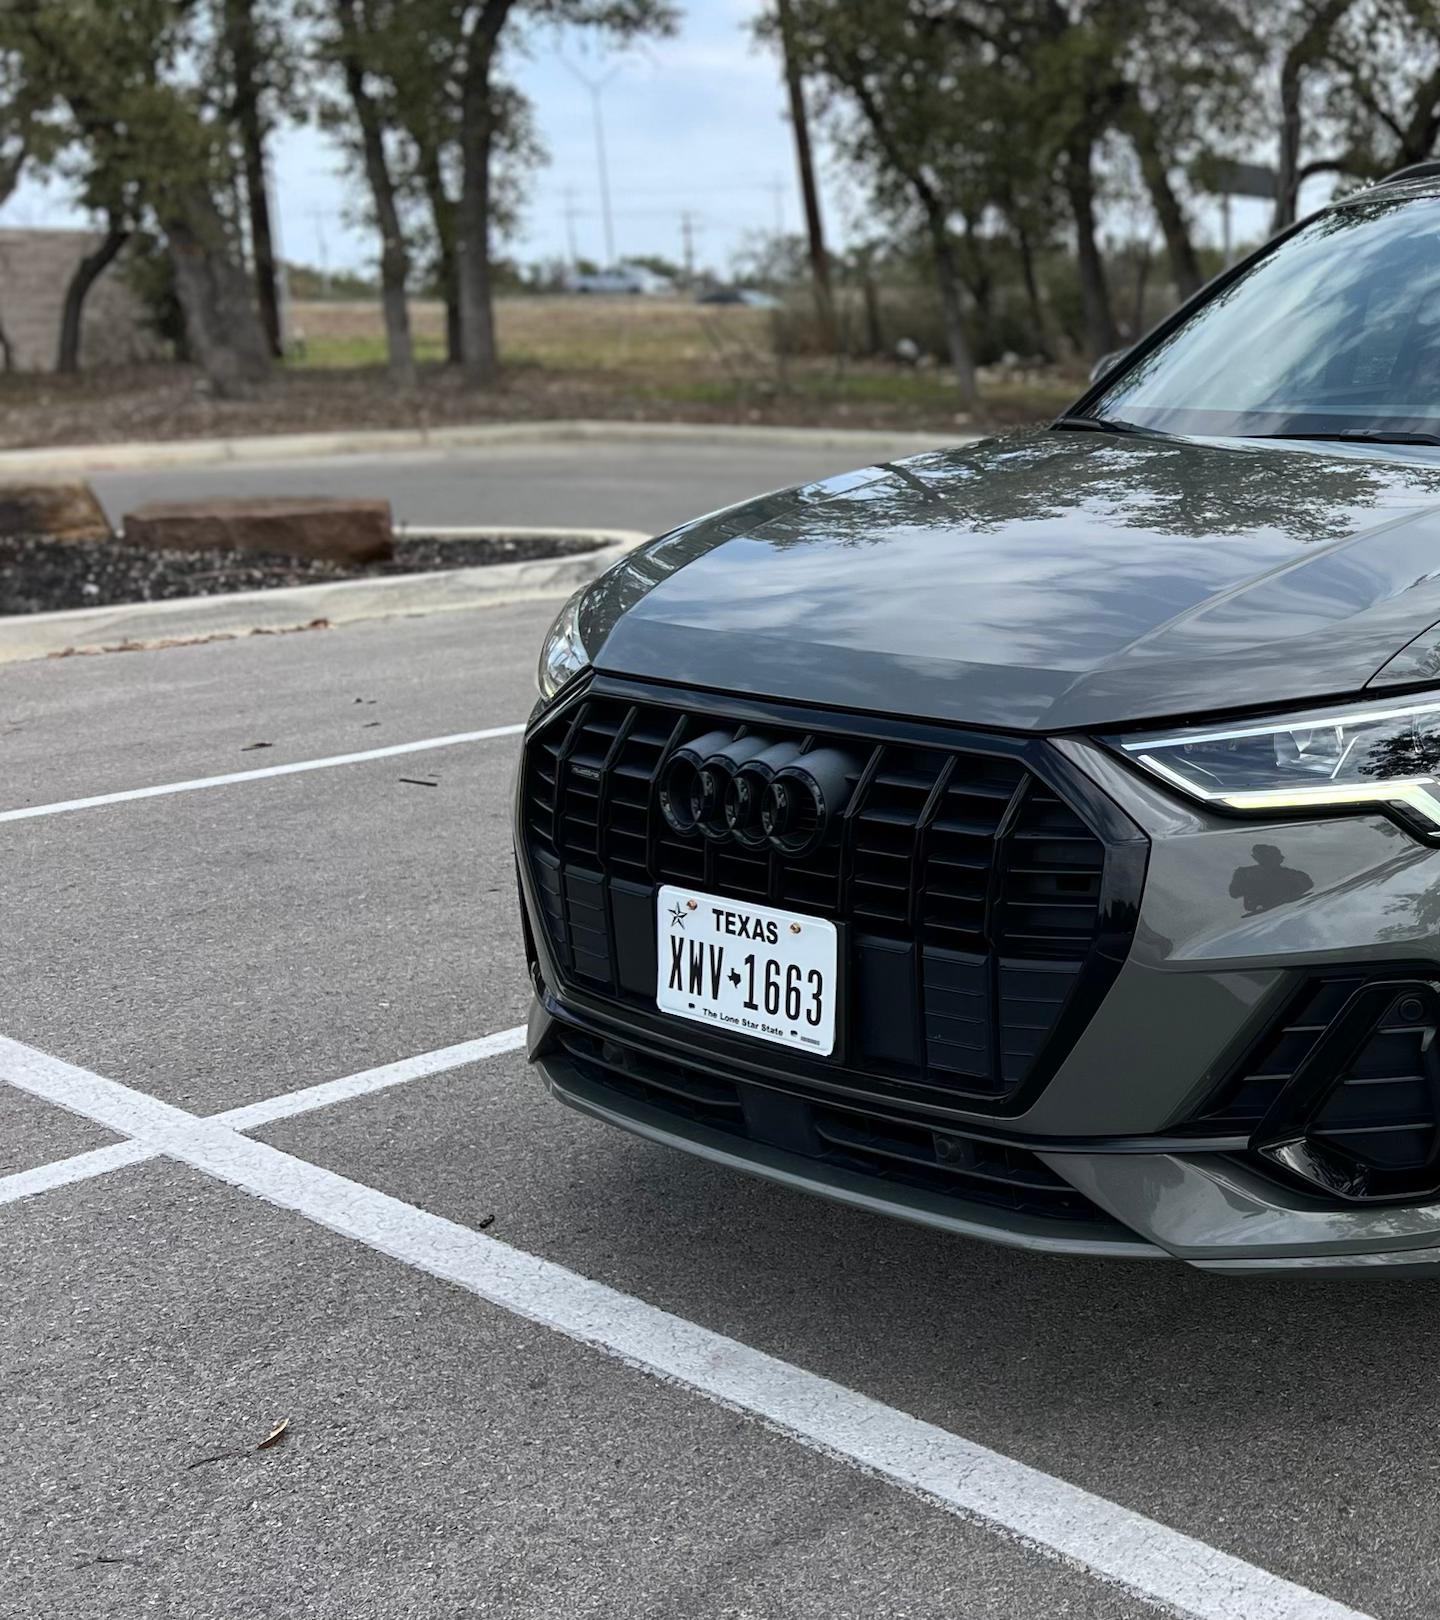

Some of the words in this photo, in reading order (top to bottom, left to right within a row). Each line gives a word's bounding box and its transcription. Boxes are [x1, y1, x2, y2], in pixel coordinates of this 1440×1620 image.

[712, 908, 778, 945] TEXAS
[703, 1008, 718, 1020] The
[720, 1013, 740, 1025] Lone
[742, 1018, 759, 1030] Star
[761, 1023, 784, 1036] State
